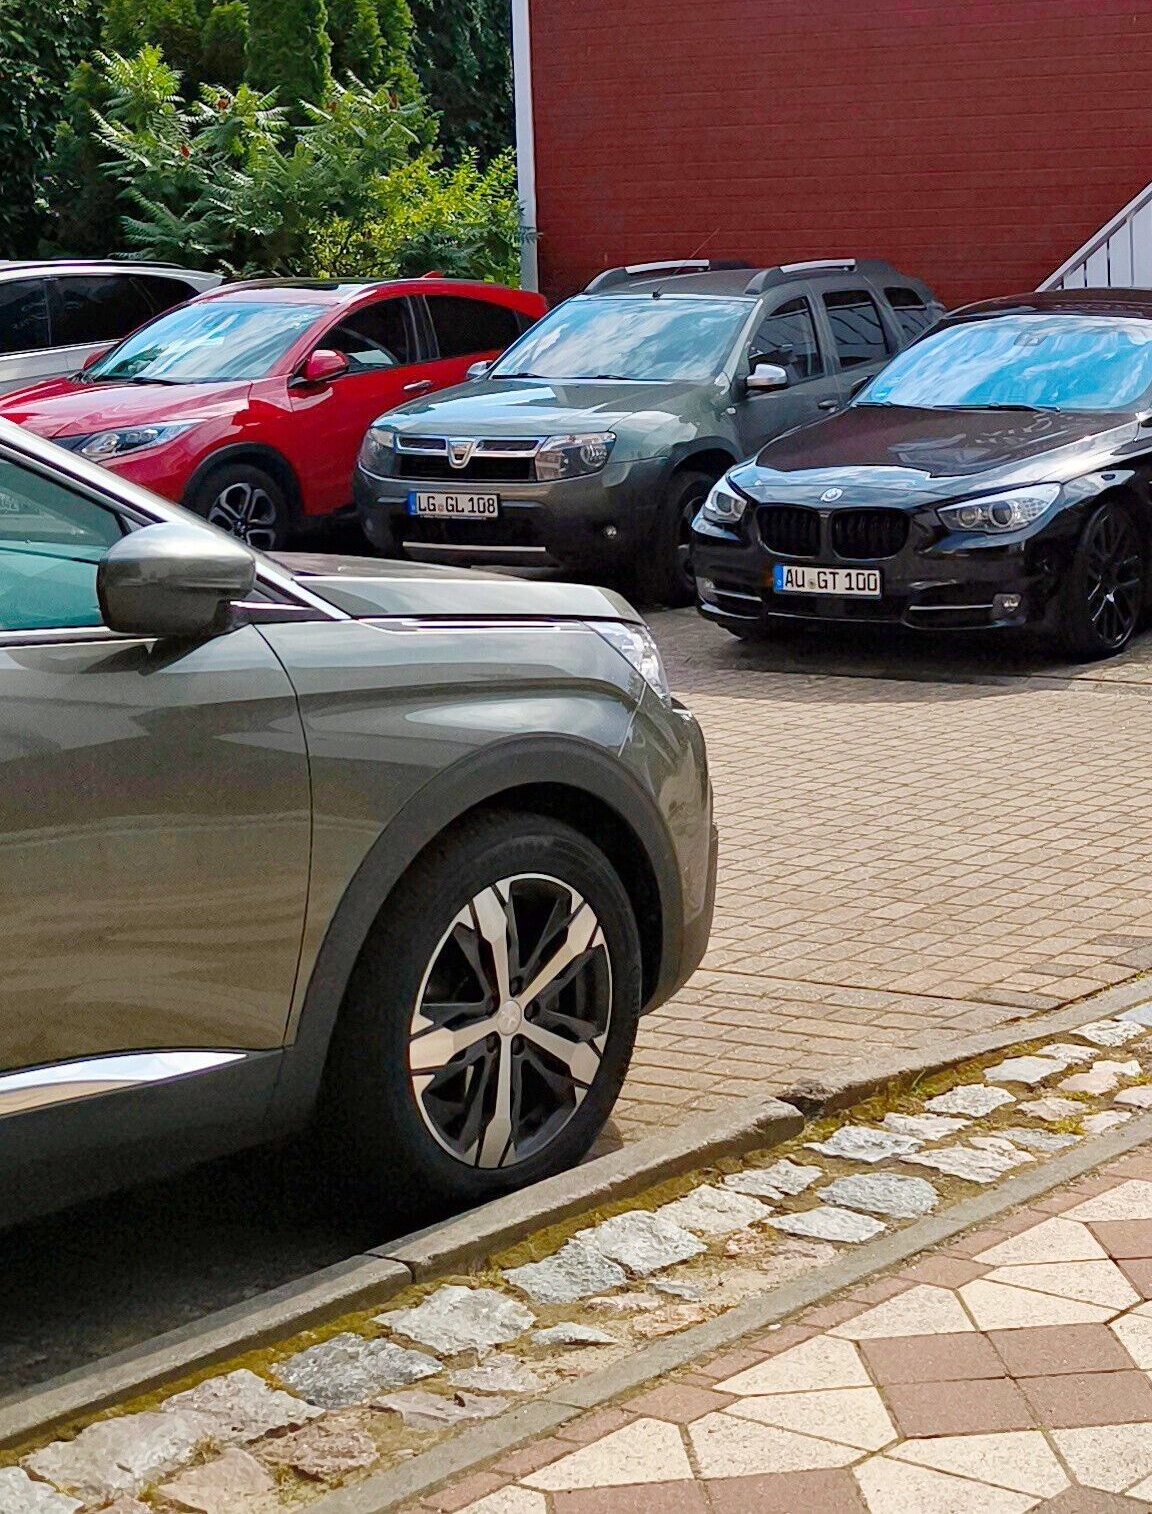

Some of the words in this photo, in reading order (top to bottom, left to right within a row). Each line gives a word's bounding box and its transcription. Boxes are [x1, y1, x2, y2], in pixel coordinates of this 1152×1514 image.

[418, 495, 437, 512] LG
[445, 496, 465, 513] GL
[467, 496, 496, 514] 108
[785, 569, 805, 588] AU
[817, 571, 839, 590] GT
[844, 572, 878, 592] 100
